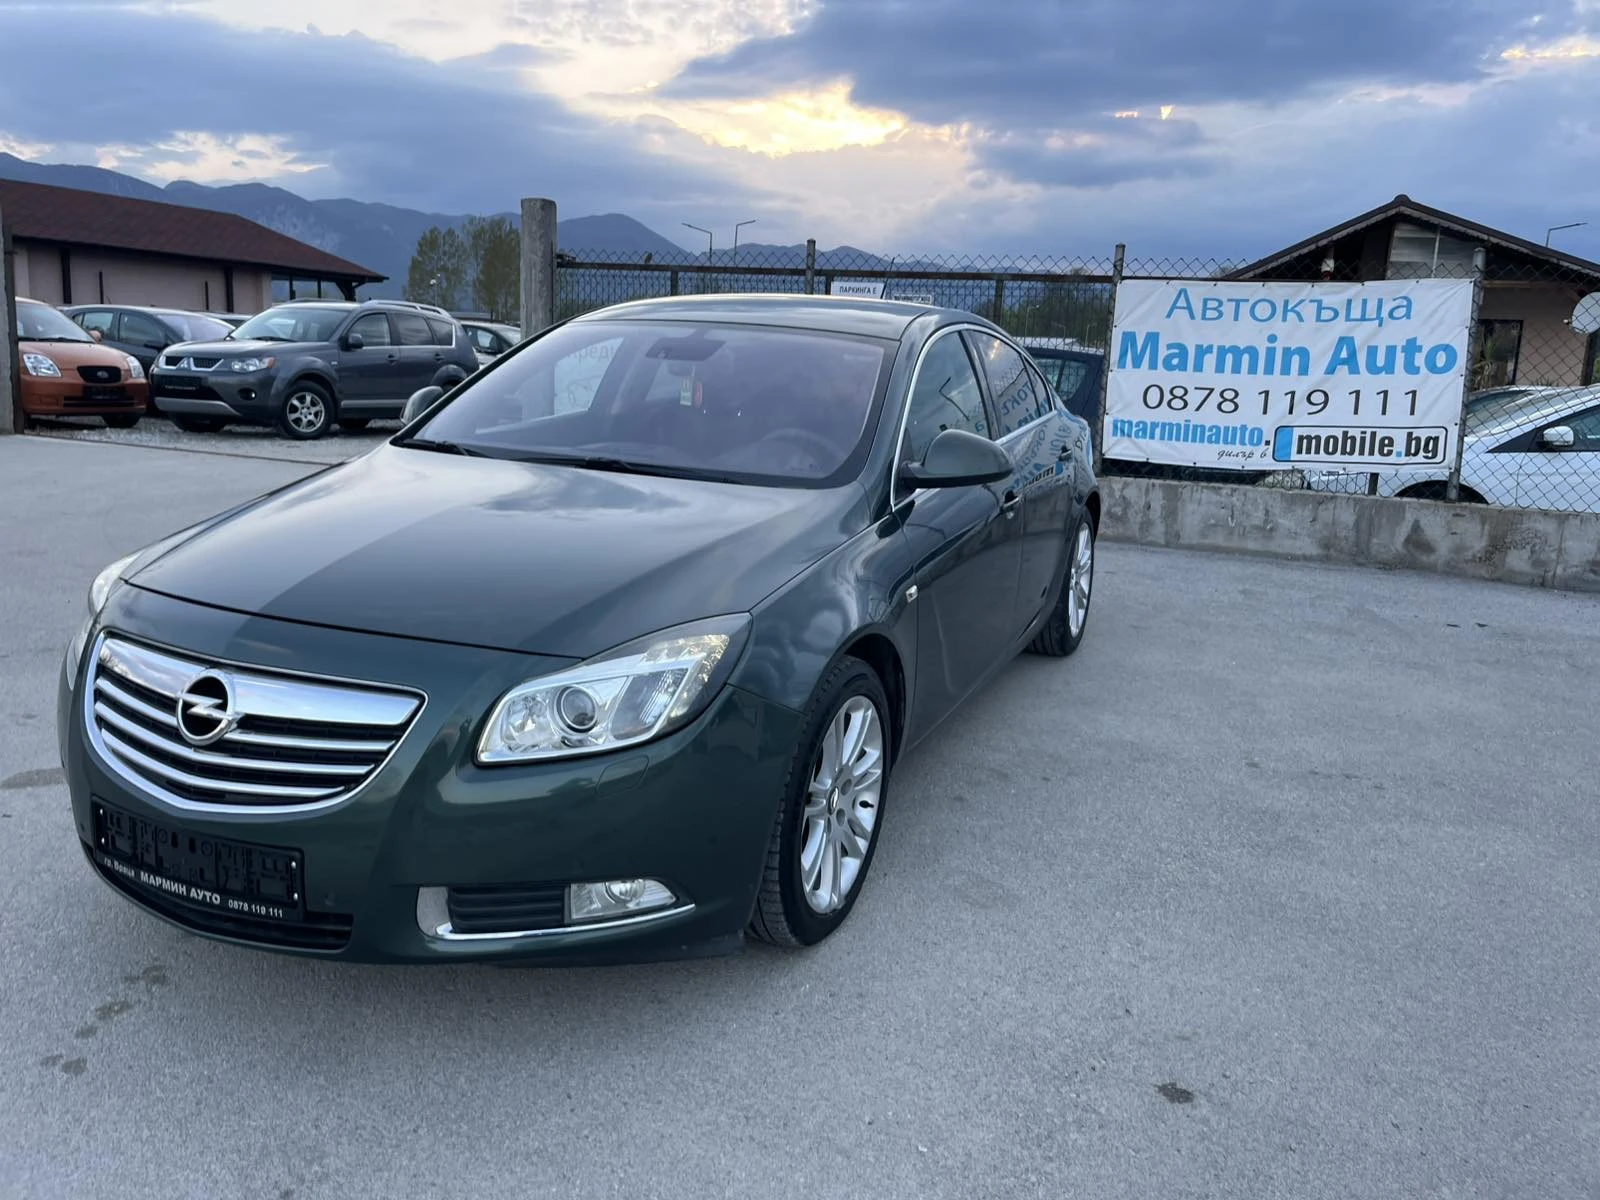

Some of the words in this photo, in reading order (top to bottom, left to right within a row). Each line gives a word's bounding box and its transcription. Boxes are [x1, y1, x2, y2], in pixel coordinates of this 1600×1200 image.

[839, 286, 871, 295] ПАРКИНГА
[1165, 287, 1414, 328] Автокъща
[1116, 331, 1311, 377] Marmin
[1325, 335, 1459, 376] Auto
[1141, 384, 1240, 414] 0878
[1257, 389, 1330, 416] 119
[1347, 389, 1418, 416] 111
[1217, 449, 1255, 461] дилър
[1296, 430, 1440, 460] mobile.bg
[140, 870, 187, 896] МАРМИН
[189, 887, 221, 905] АУТО
[228, 899, 249, 912] 0878
[268, 907, 283, 918] 111
